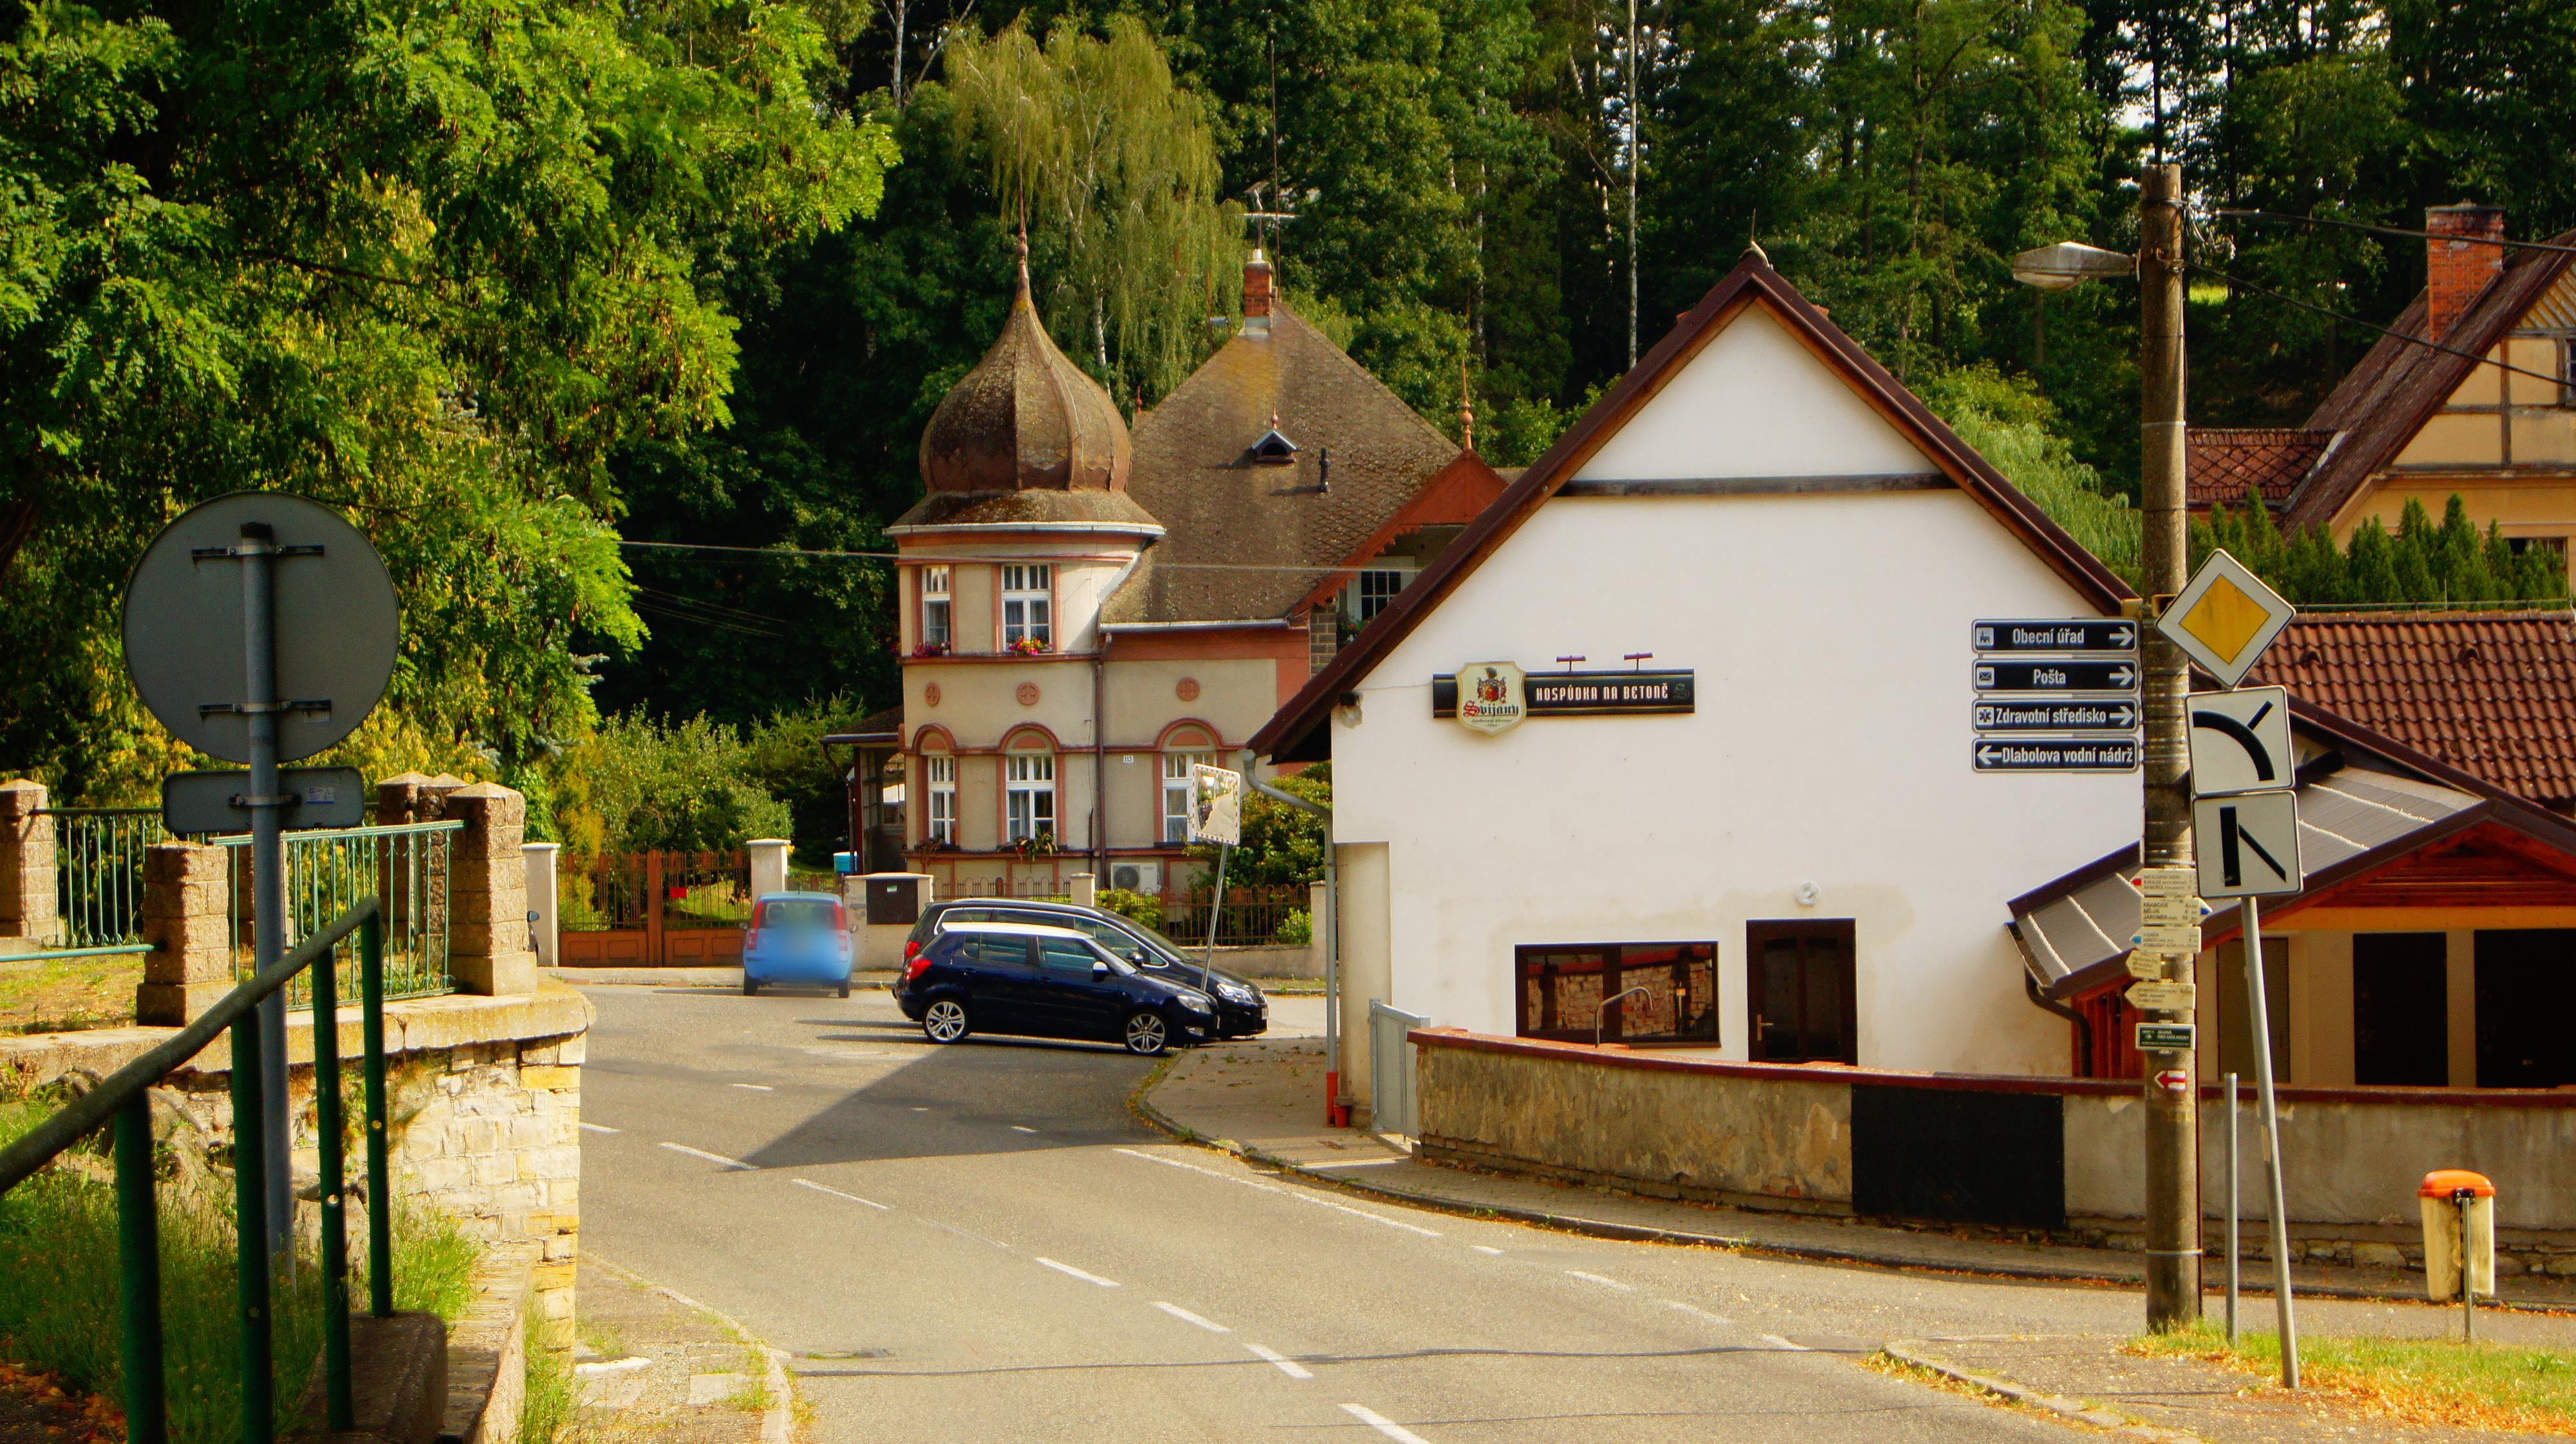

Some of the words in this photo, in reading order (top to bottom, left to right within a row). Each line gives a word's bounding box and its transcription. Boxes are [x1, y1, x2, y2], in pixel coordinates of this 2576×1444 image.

[2012, 628, 2054, 644] Obecní
[2057, 628, 2085, 644] úřad
[2033, 668, 2067, 684] Pošta
[1603, 686, 1618, 700] NA
[1623, 682, 1669, 700] BETONĚ
[1463, 700, 1519, 717] Svijany
[1996, 708, 2050, 723] Zdravotní
[2052, 707, 2107, 723] středisko
[2002, 747, 2060, 763] Dlabolova
[2063, 747, 2096, 763] vodní
[2099, 747, 2133, 763] nádrž
